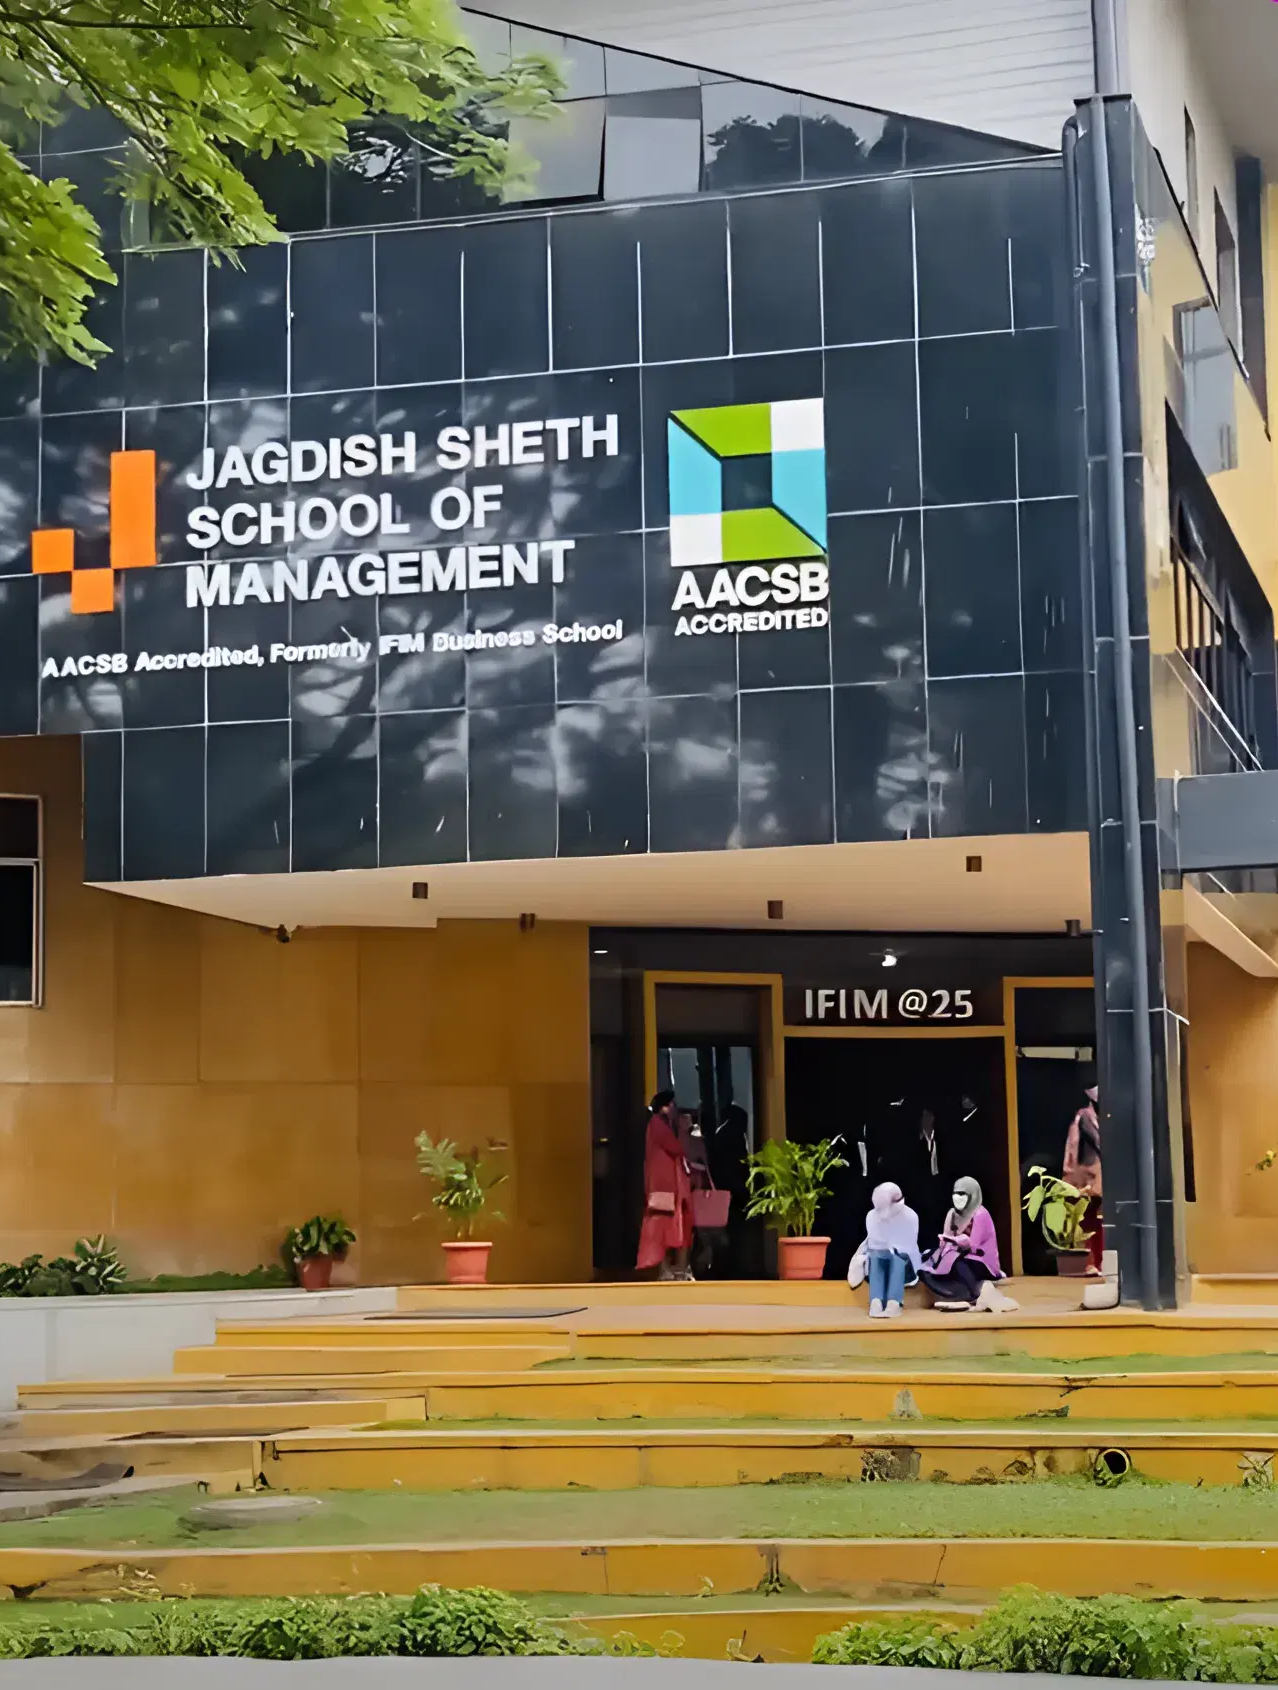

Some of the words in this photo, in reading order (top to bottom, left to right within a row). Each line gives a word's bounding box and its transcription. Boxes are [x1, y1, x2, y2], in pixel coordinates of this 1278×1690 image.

[186, 431, 416, 490] JAGDISH
[436, 414, 619, 470] SHETH
[186, 492, 411, 549] SCHOOL
[430, 485, 503, 531] OF
[186, 540, 575, 608] MANAGEMENT
[671, 562, 830, 611] AACSB
[42, 653, 128, 678] AACSB
[134, 644, 265, 672] Accredited,
[270, 634, 371, 663] Formerly
[432, 629, 536, 652] Business
[542, 619, 623, 644] School
[674, 607, 829, 636] ACCREDITED
